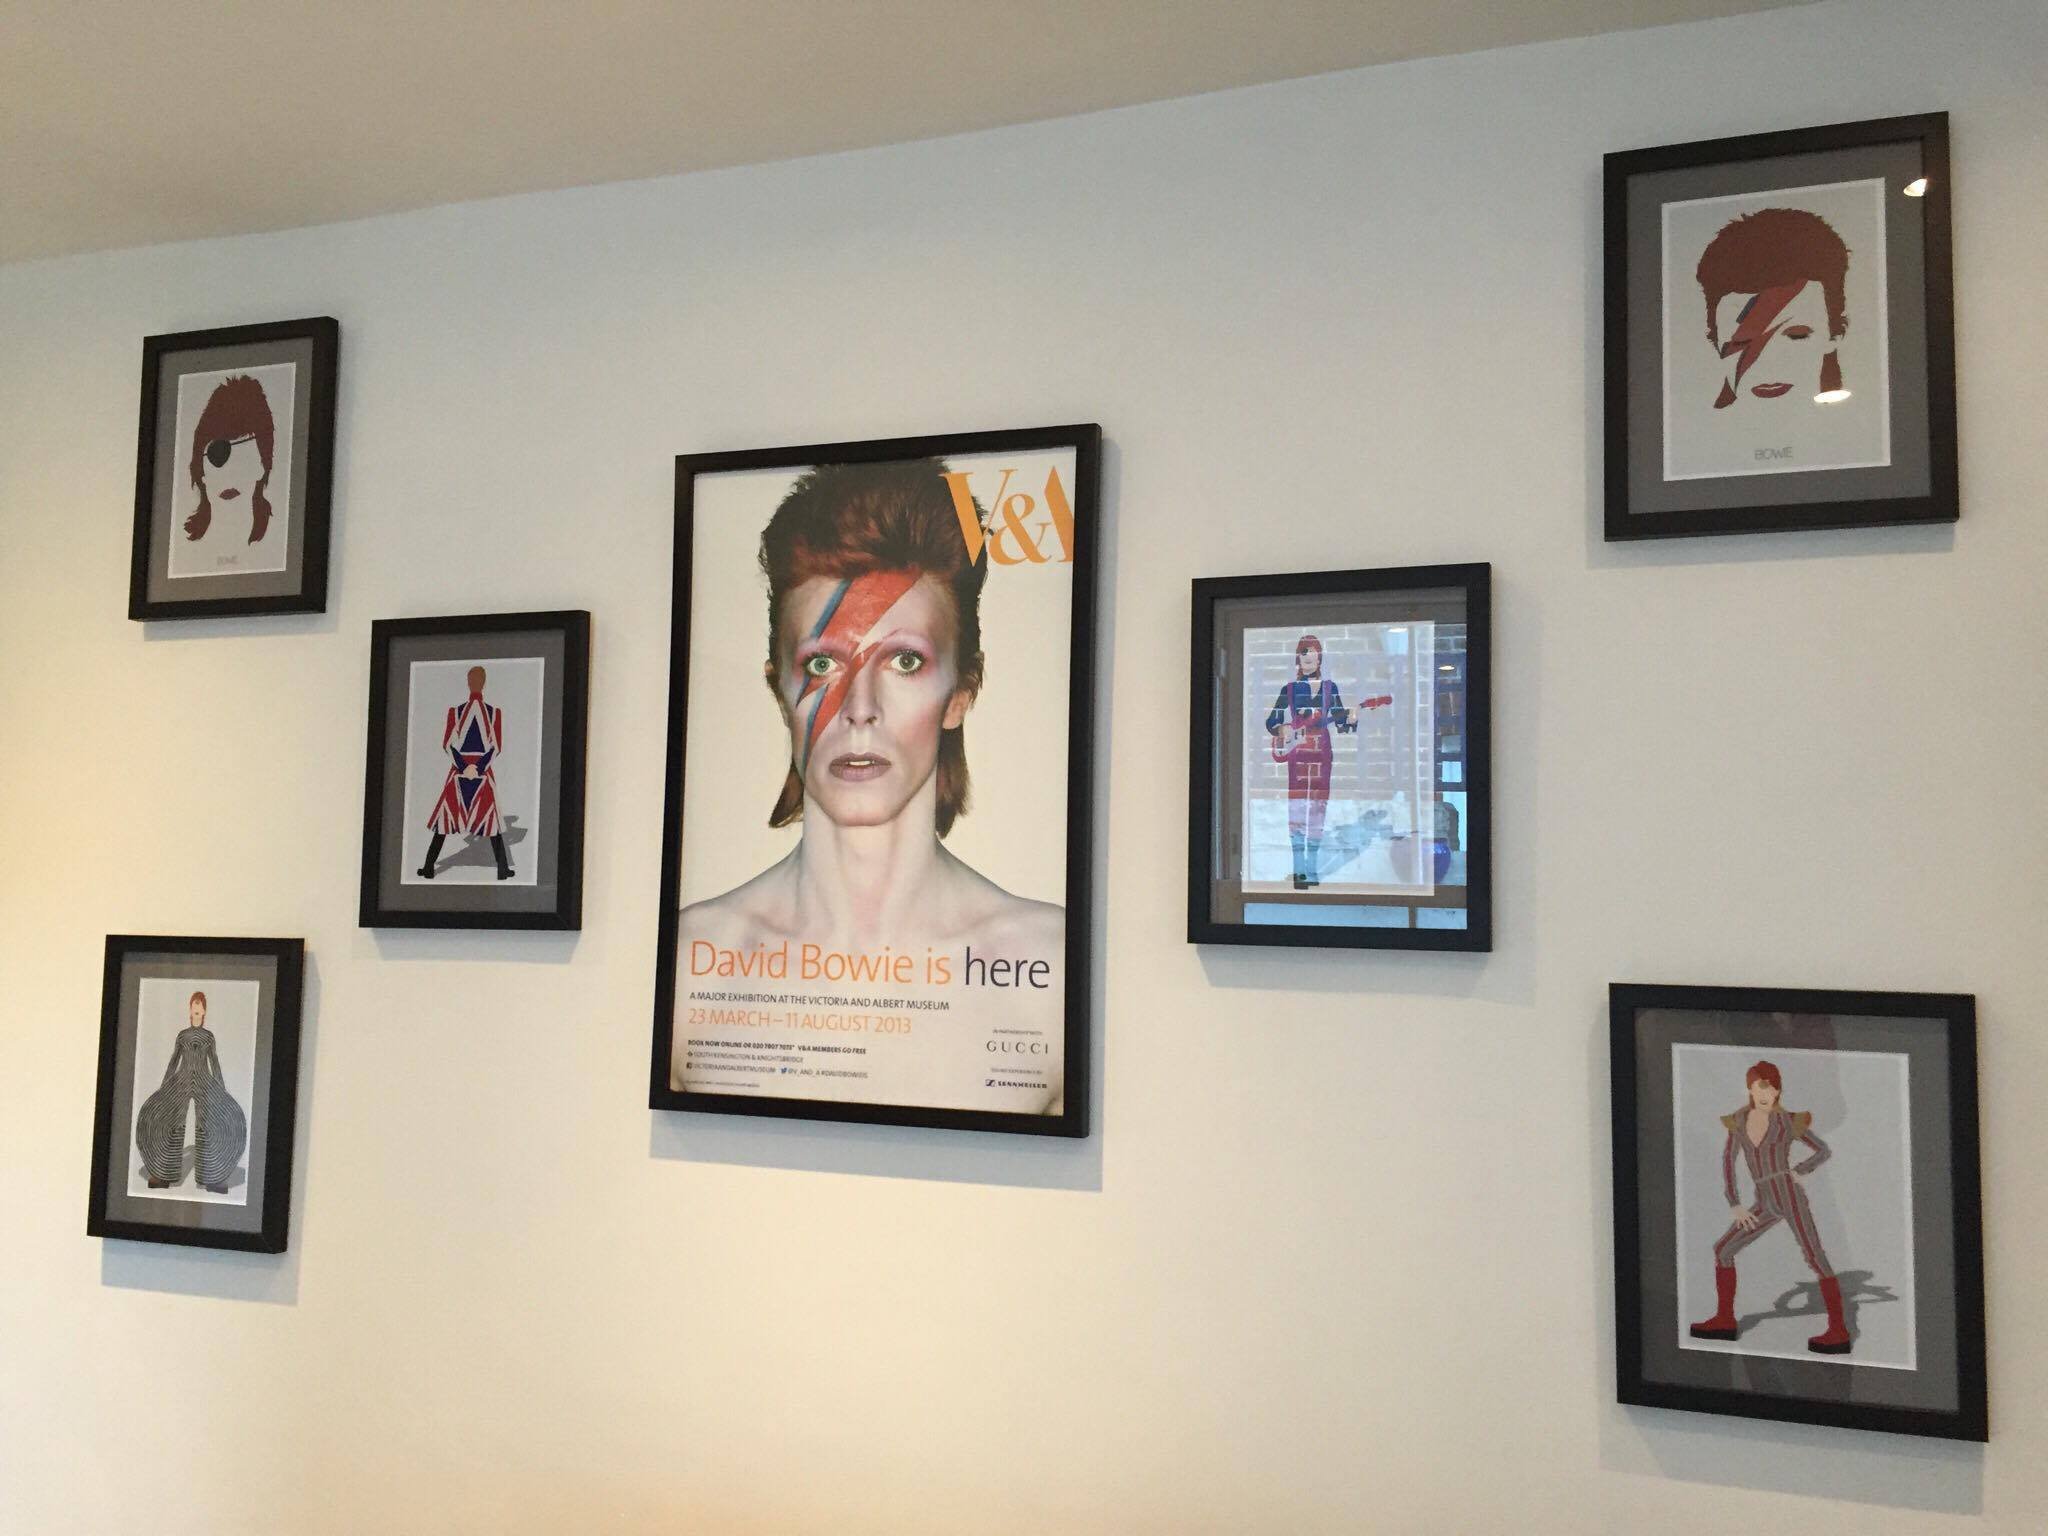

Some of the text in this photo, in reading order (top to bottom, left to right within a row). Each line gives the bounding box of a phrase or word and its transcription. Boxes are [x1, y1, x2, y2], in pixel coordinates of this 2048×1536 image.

[1754, 446, 1793, 460] BOWIE
[938, 465, 1075, 568] V&A
[690, 940, 1050, 989] David Bowie is here
[689, 992, 950, 1011] A MAJOR EXHIBITION AT THE VICTORIA AND ALBERT MUSEUM
[688, 1007, 706, 1025] 23
[708, 1009, 771, 1027] MARCH
[785, 1012, 799, 1029] 11
[800, 1013, 872, 1032] AUGUST
[874, 1016, 912, 1034] 2013
[986, 1040, 1048, 1054] GUCCI
[997, 1080, 1048, 1089] SENNHEISER
